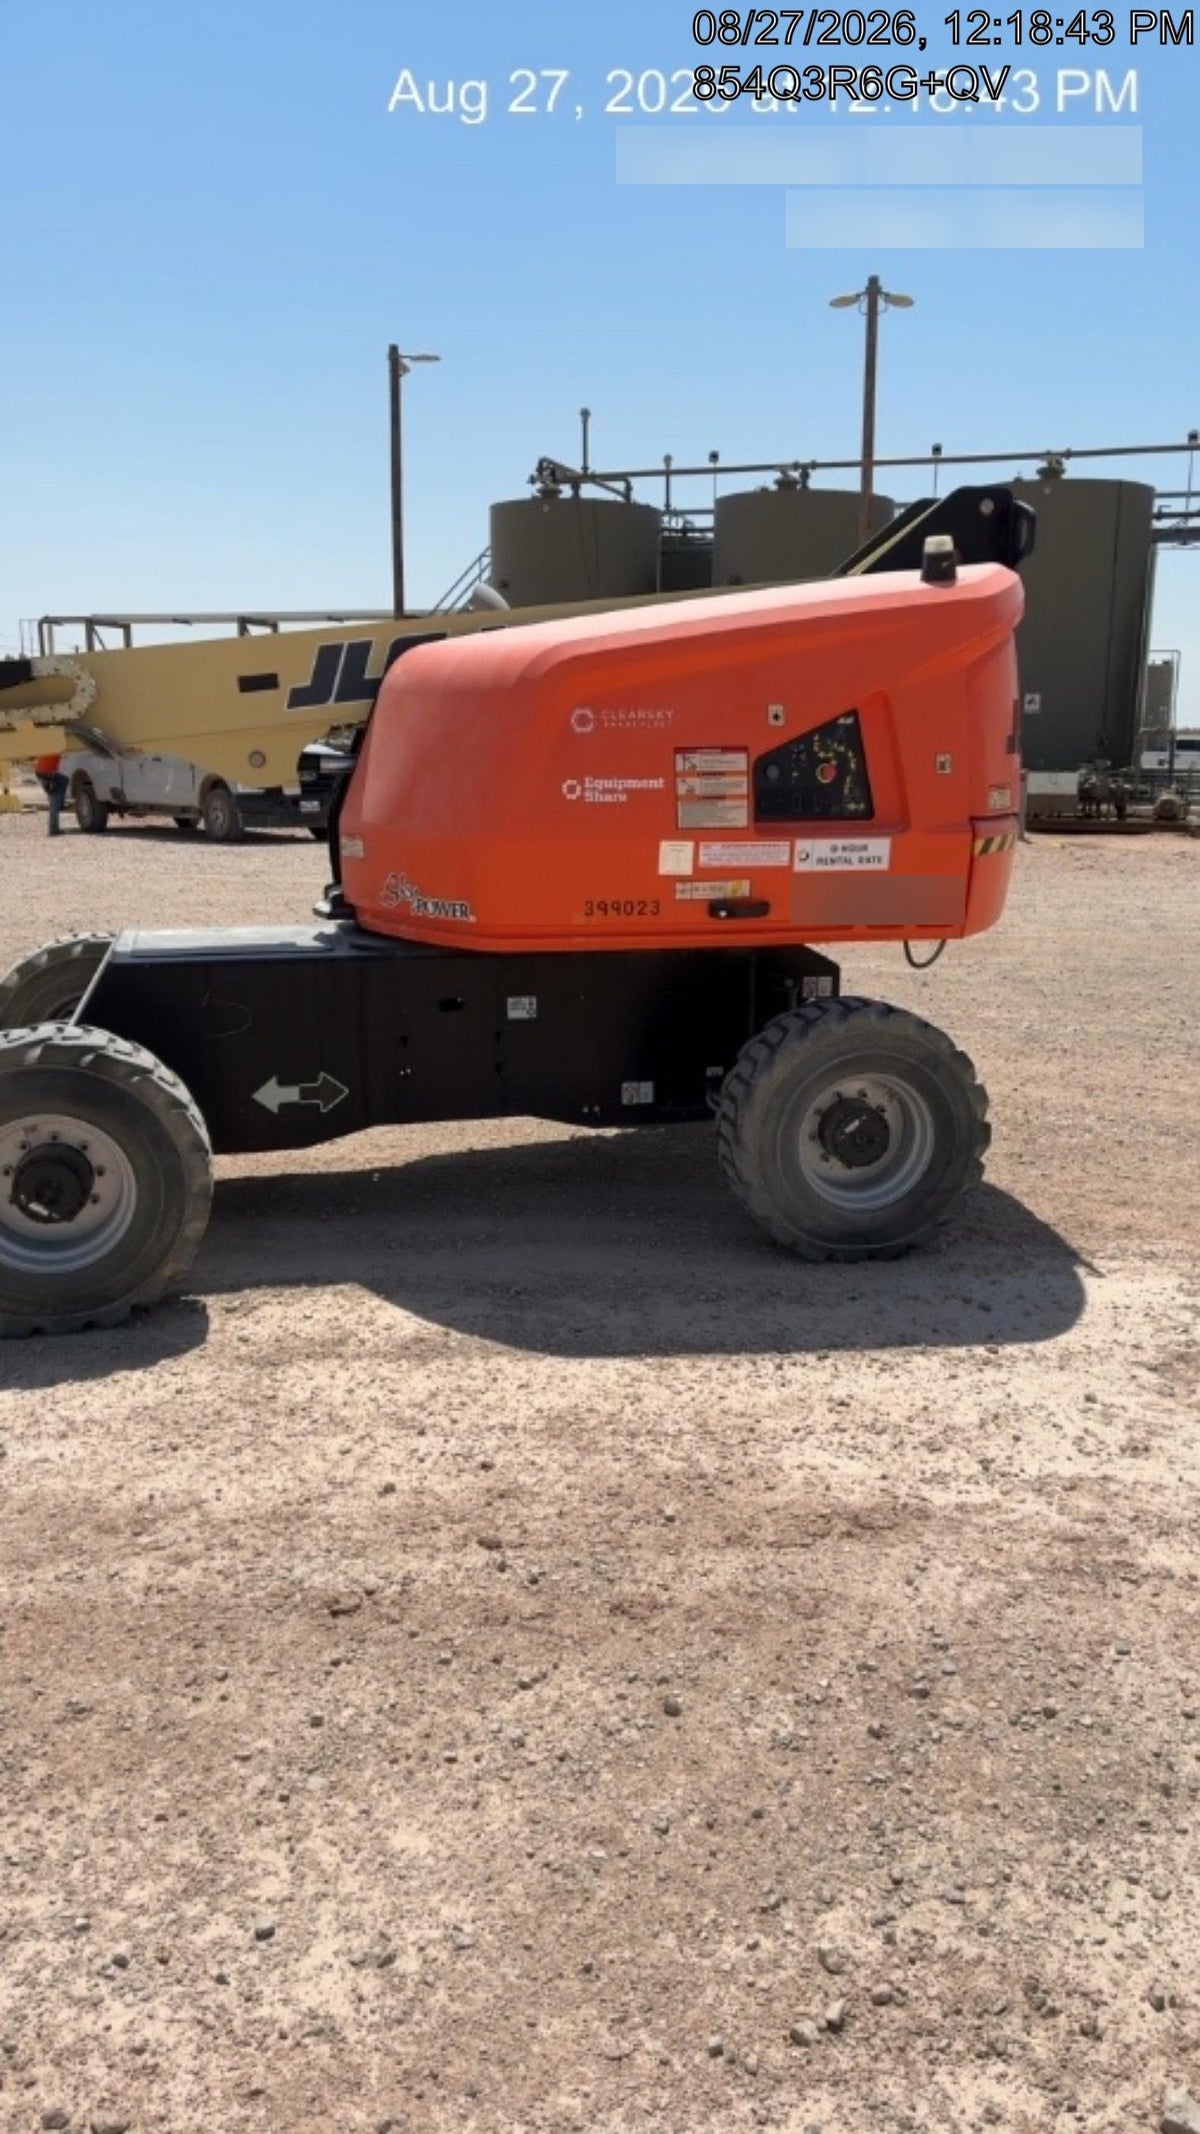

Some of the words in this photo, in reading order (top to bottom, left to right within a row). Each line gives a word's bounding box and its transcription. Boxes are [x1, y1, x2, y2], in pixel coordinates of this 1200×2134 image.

[286, 632, 447, 710] JL
[584, 777, 665, 790] Equipment
[584, 790, 628, 802] Share
[411, 896, 470, 920] POWER
[584, 900, 661, 916] 399023
